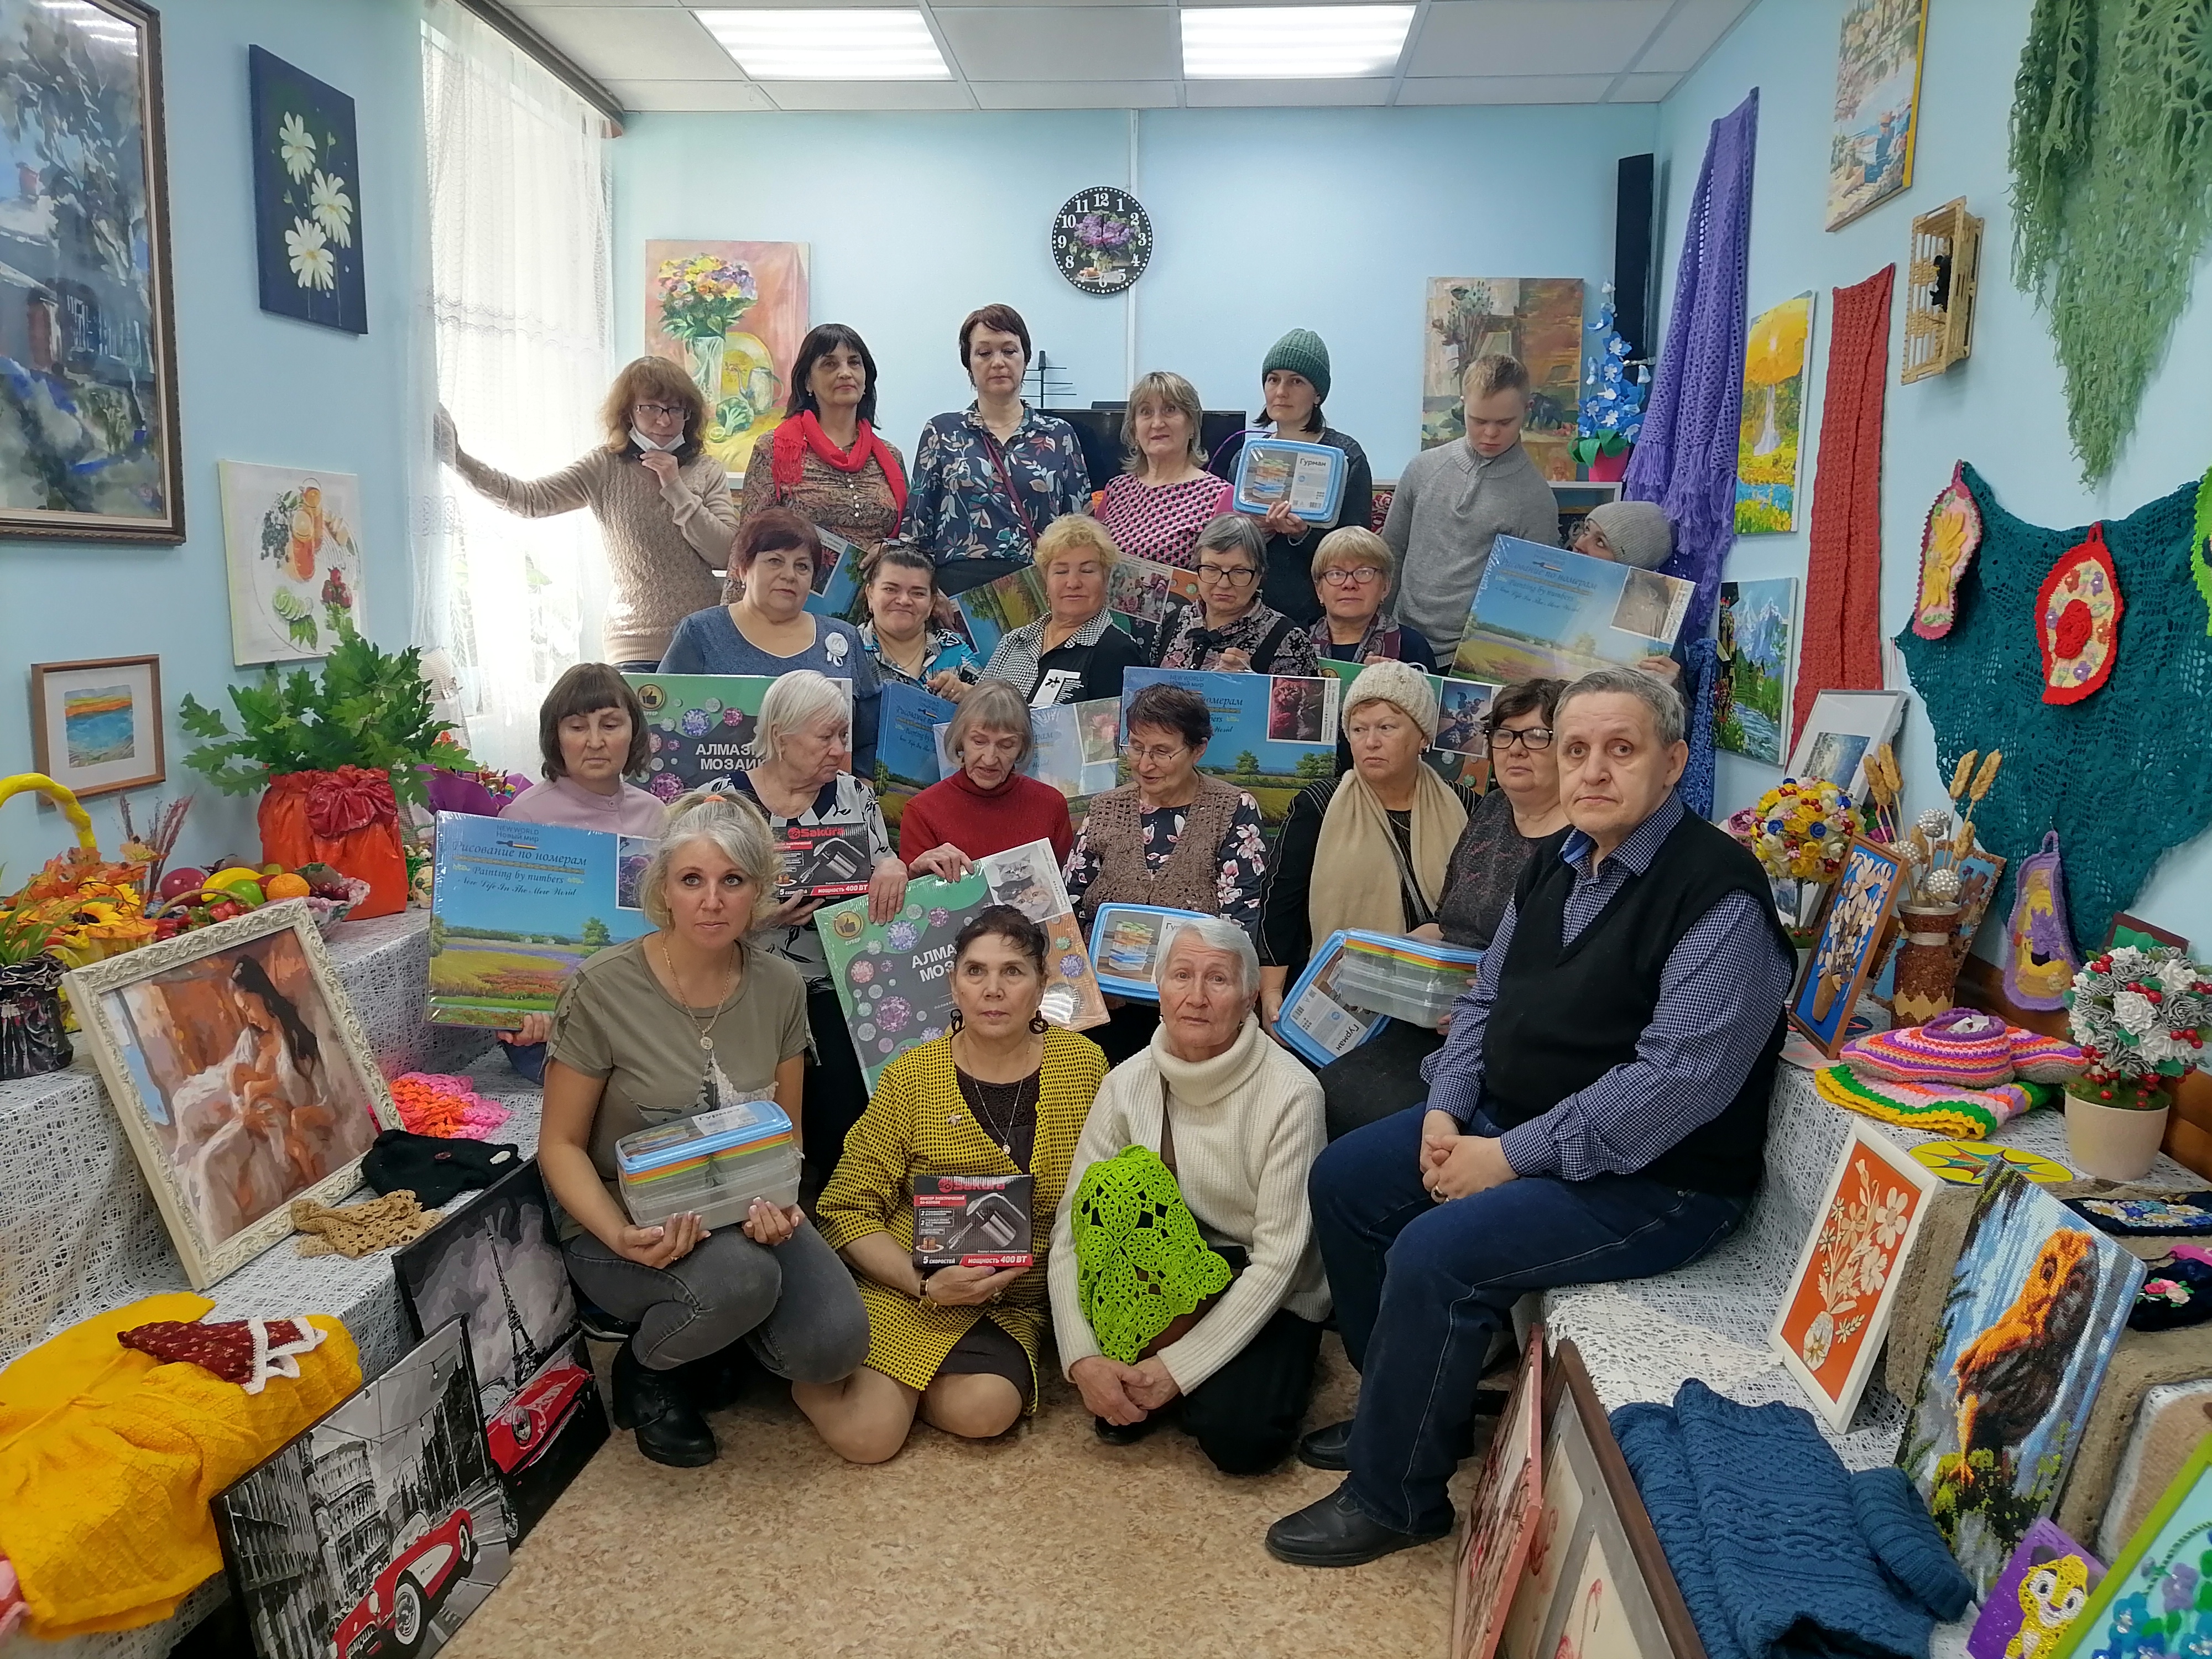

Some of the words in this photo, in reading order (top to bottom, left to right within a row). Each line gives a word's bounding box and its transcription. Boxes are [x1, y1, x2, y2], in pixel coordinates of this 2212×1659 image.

[1075, 199, 1089, 212] 11
[1093, 193, 1109, 207] 12
[1117, 198, 1124, 212] 1
[1061, 215, 1077, 228] 10
[1130, 212, 1139, 226] 2
[1057, 235, 1067, 248] 9
[1138, 233, 1146, 246] 3
[1065, 255, 1074, 268] 8
[1131, 253, 1140, 267] 4
[1099, 274, 1107, 288] 6
[1118, 268, 1126, 281] 5
[1300, 458, 1326, 467] Гурман
[1204, 697, 1243, 710] омерам
[695, 744, 755, 755] АЛМАЗ
[701, 758, 765, 770] МОЗАИК
[496, 831, 523, 841] Новый
[524, 834, 539, 843] мир
[513, 827, 539, 835] WORLD
[801, 827, 844, 837] Sakura
[453, 841, 515, 857] Рисование
[518, 851, 531, 860] по
[535, 853, 587, 867] номерам
[473, 866, 512, 880] Painting
[515, 870, 525, 883] by
[528, 873, 564, 884] numbers
[912, 943, 958, 969] АЛМА
[919, 960, 955, 983] МОЗ
[1335, 1024, 1360, 1051] Гурман
[923, 1256, 929, 1264] 5
